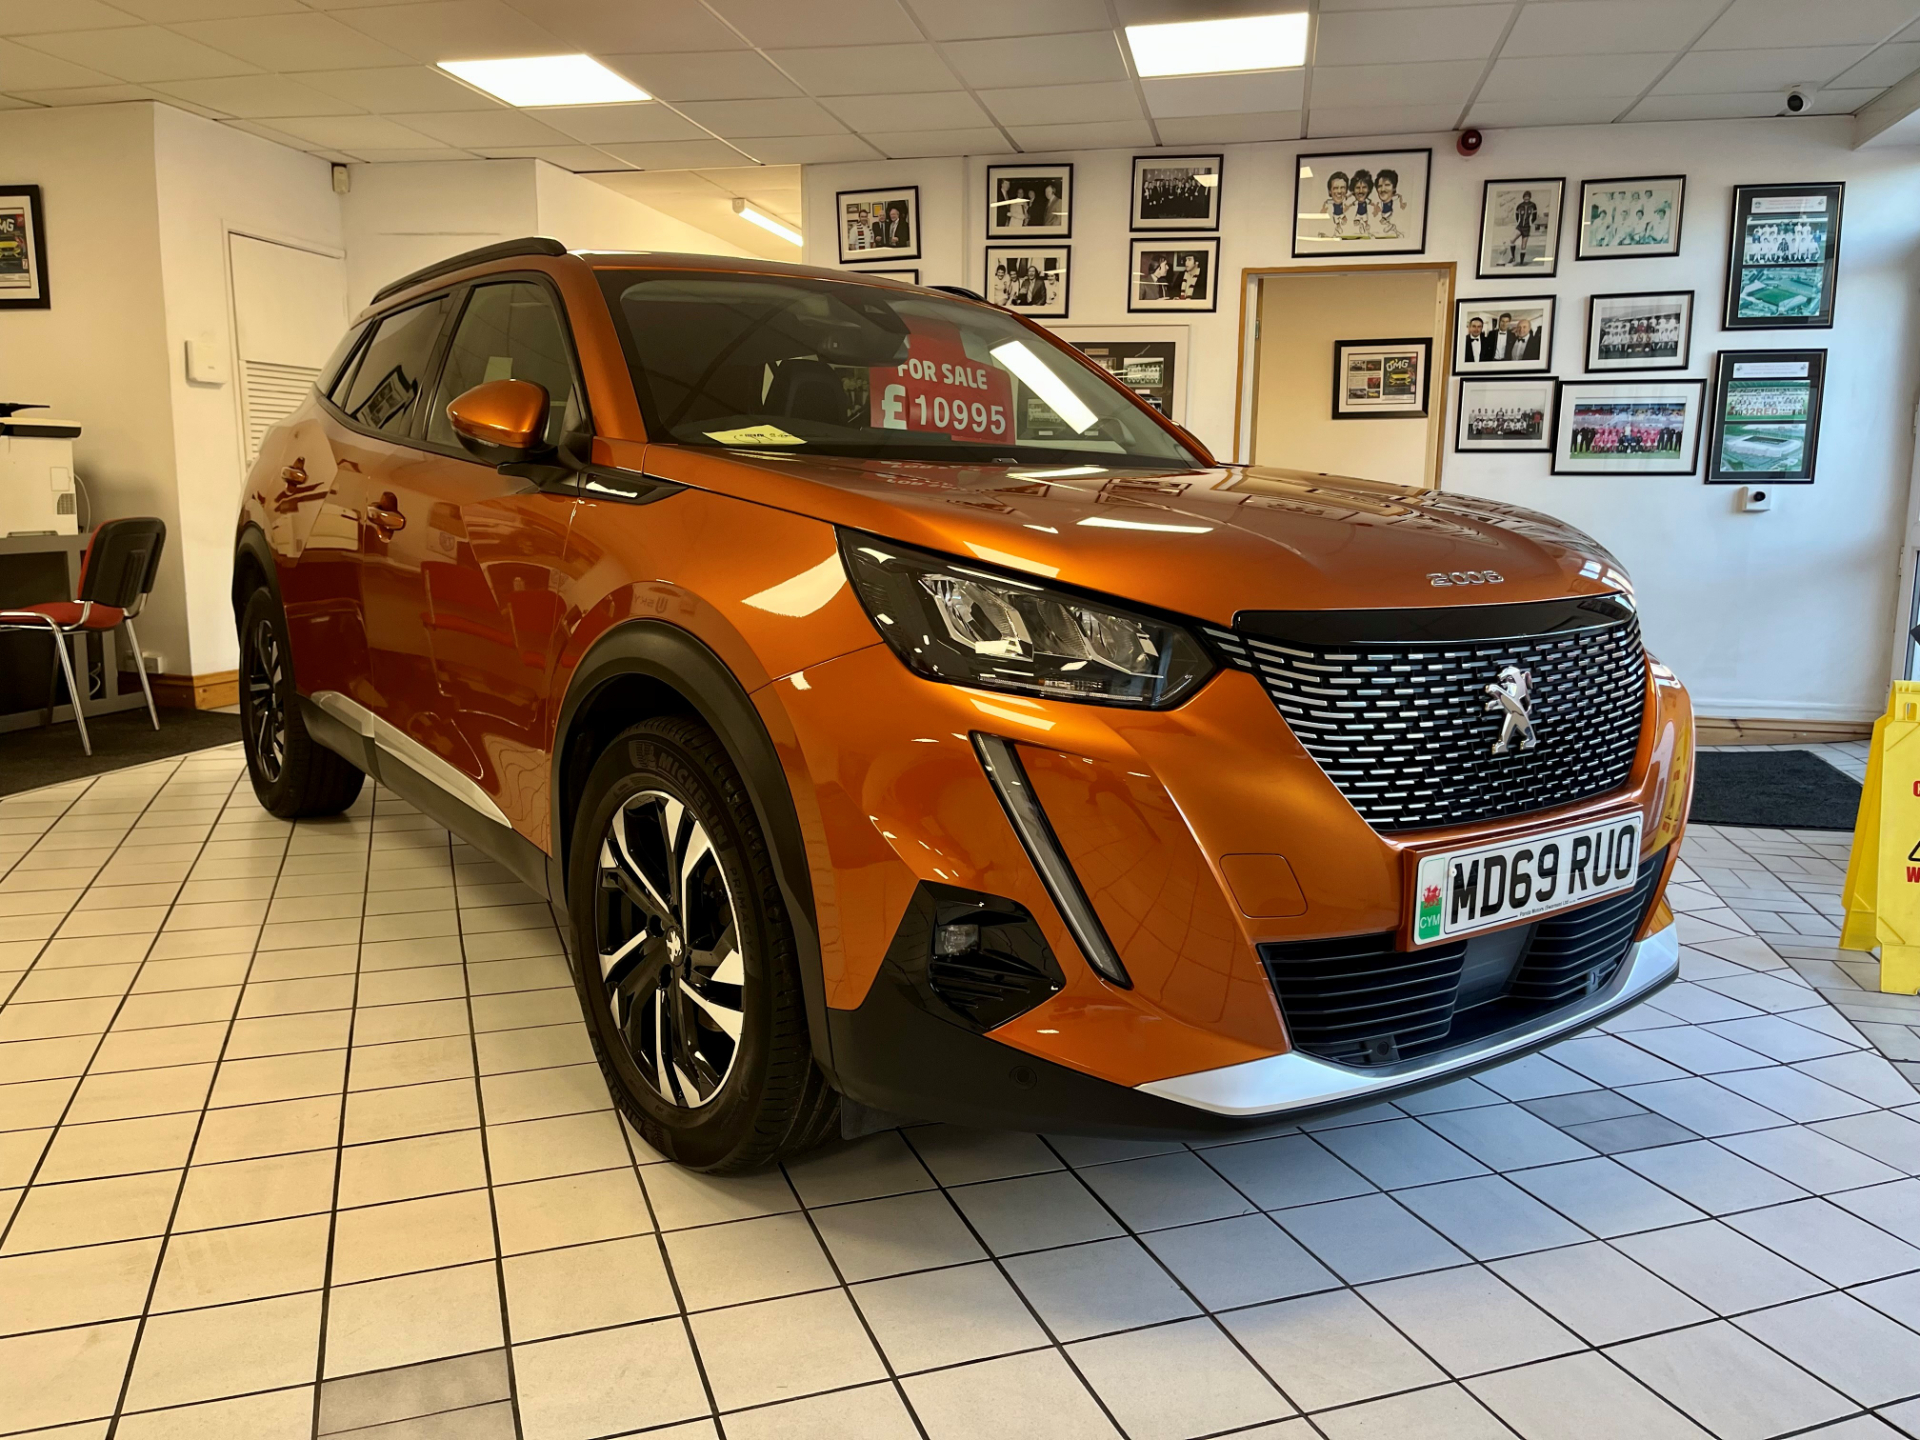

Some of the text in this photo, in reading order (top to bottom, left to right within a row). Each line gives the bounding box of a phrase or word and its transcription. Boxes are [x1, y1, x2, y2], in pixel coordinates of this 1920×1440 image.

[898, 358, 988, 390] FOR SALE
[1426, 570, 1504, 587] 2008
[658, 753, 728, 846] MICHELIN
[1450, 824, 1636, 925] MD69 RUO
[729, 868, 754, 951] PRIMACY
[1419, 914, 1441, 929] CYM
